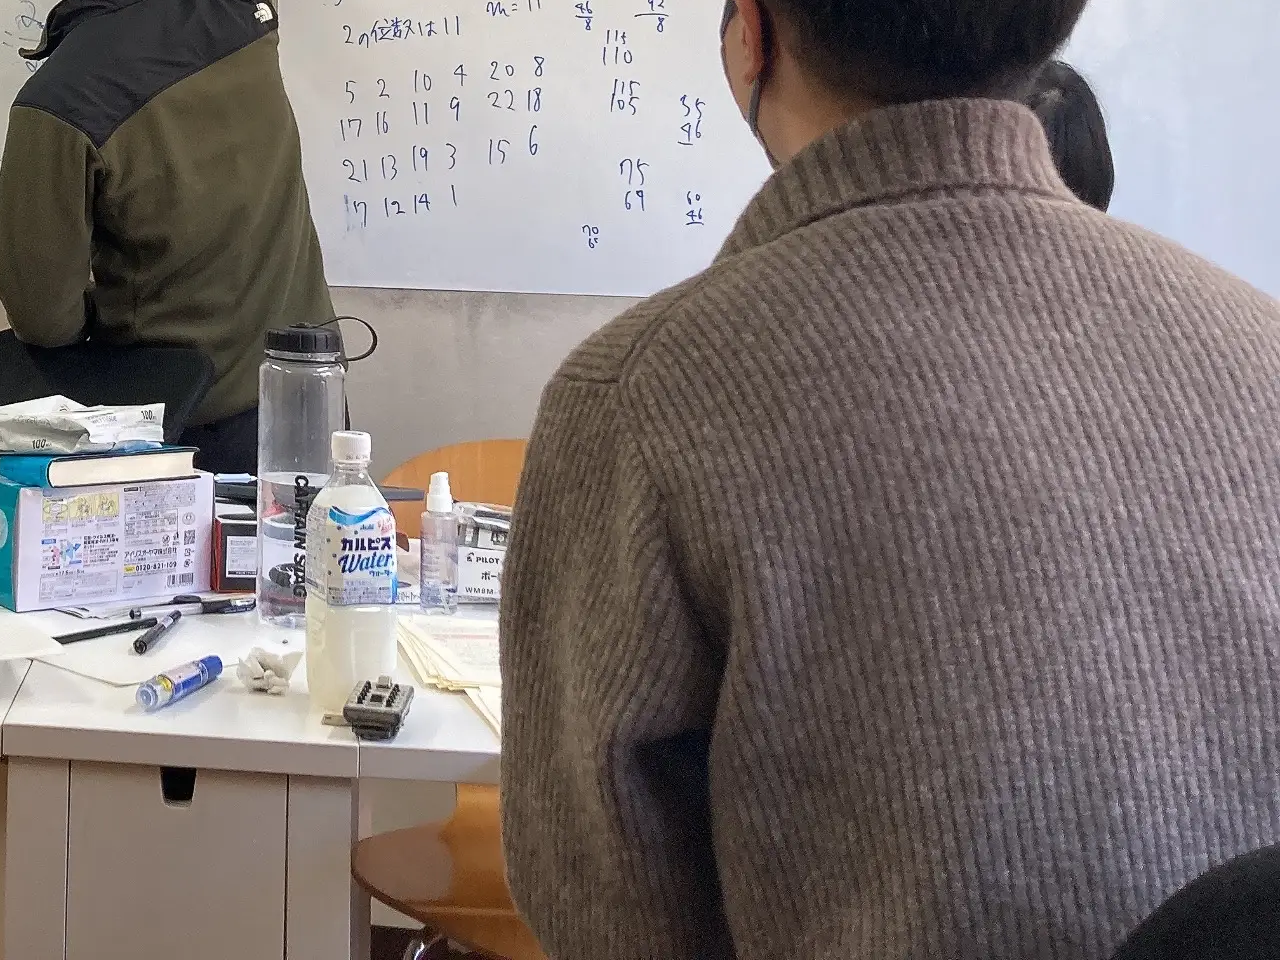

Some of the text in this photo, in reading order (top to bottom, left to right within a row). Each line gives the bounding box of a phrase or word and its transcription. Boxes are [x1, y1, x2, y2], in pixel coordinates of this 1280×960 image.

[345, 81, 356, 103] 5
[377, 78, 390, 98] 2
[414, 69, 432, 92] 10
[453, 64, 467, 86] 4
[534, 56, 545, 77] 8
[340, 119, 361, 141] 17
[450, 97, 460, 121] 9
[487, 89, 515, 111] 22
[527, 88, 542, 112] 18
[342, 125, 538, 183] 21 13 19 3 15 6
[384, 197, 405, 217] 12
[341, 537, 391, 551] カルピス
[338, 553, 393, 573] Water
[476, 556, 500, 564] PILOT
